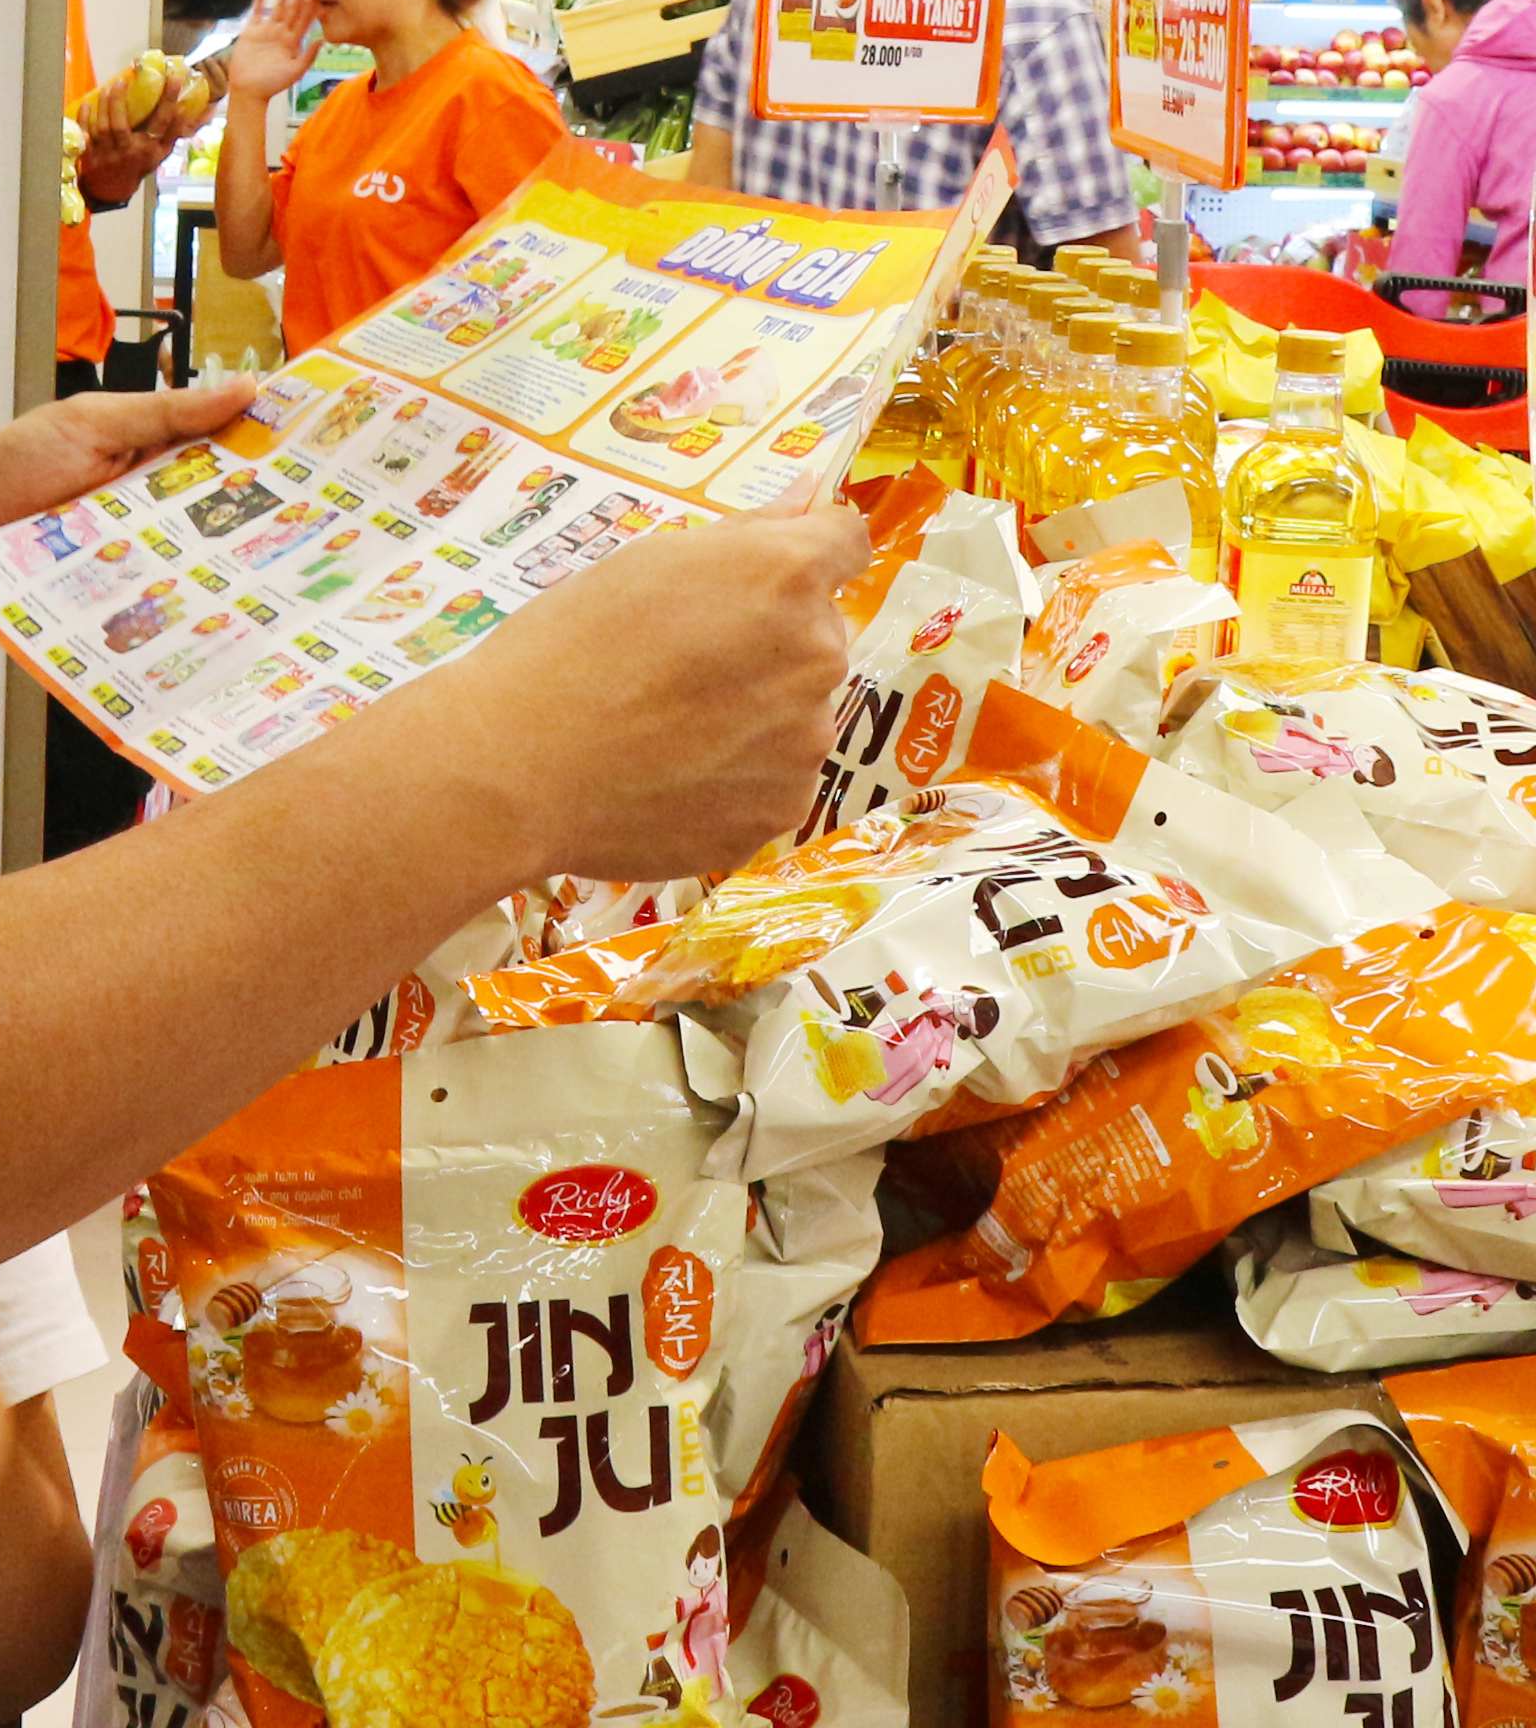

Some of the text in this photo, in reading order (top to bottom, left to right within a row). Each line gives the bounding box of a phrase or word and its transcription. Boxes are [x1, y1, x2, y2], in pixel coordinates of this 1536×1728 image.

[967, 0, 976, 29] 1
[861, 44, 902, 67] 28.000
[1179, 17, 1226, 84] 26.500
[657, 217, 890, 309] ĐỒNG GIÁ
[1290, 584, 1335, 596] MEIZAN
[243, 1213, 277, 1229] Không
[543, 1170, 633, 1231] Richy
[659, 1259, 701, 1358] 진주
[467, 1294, 636, 1425] JIN
[539, 1405, 672, 1538] JU
[677, 1399, 706, 1497] GOLD
[223, 1499, 278, 1526] KOREA
[1302, 1465, 1389, 1517] Richy
[1269, 1568, 1434, 1703] JIN
